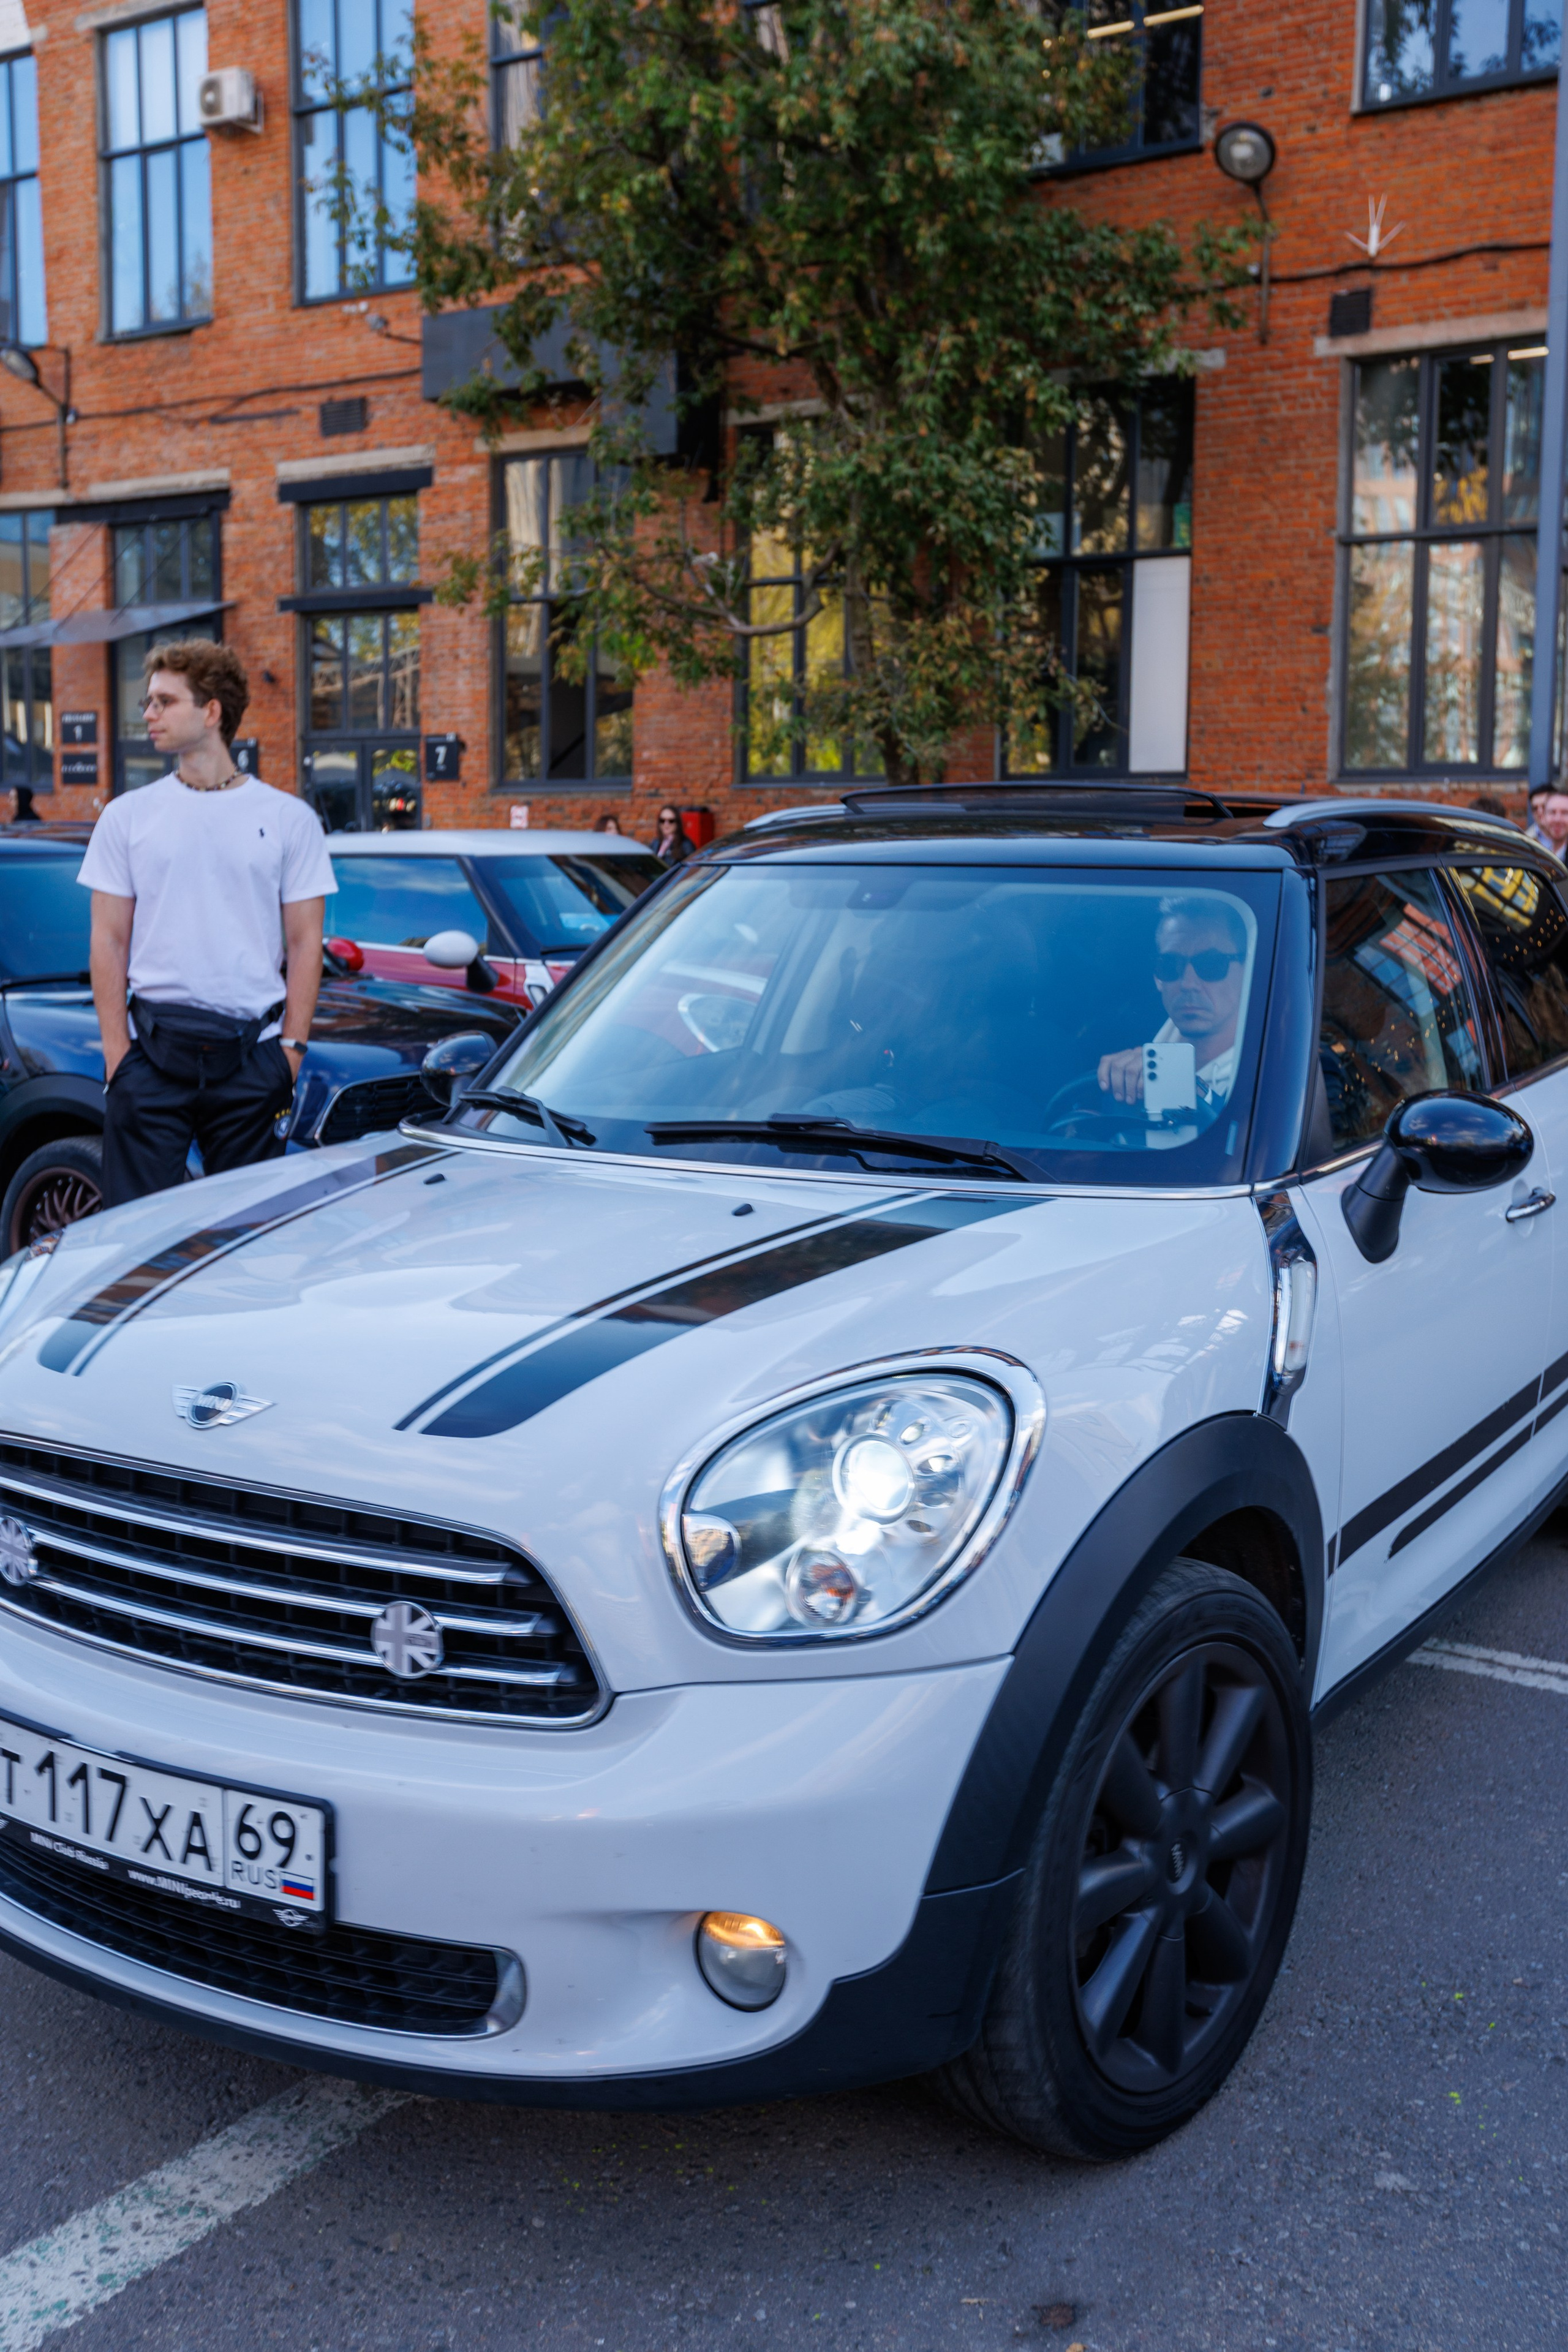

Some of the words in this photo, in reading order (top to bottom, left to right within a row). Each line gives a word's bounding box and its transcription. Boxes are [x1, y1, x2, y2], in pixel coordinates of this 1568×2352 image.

[435, 745, 447, 764] 7
[235, 1803, 297, 1868] 69
[232, 1860, 277, 1890] RUS
